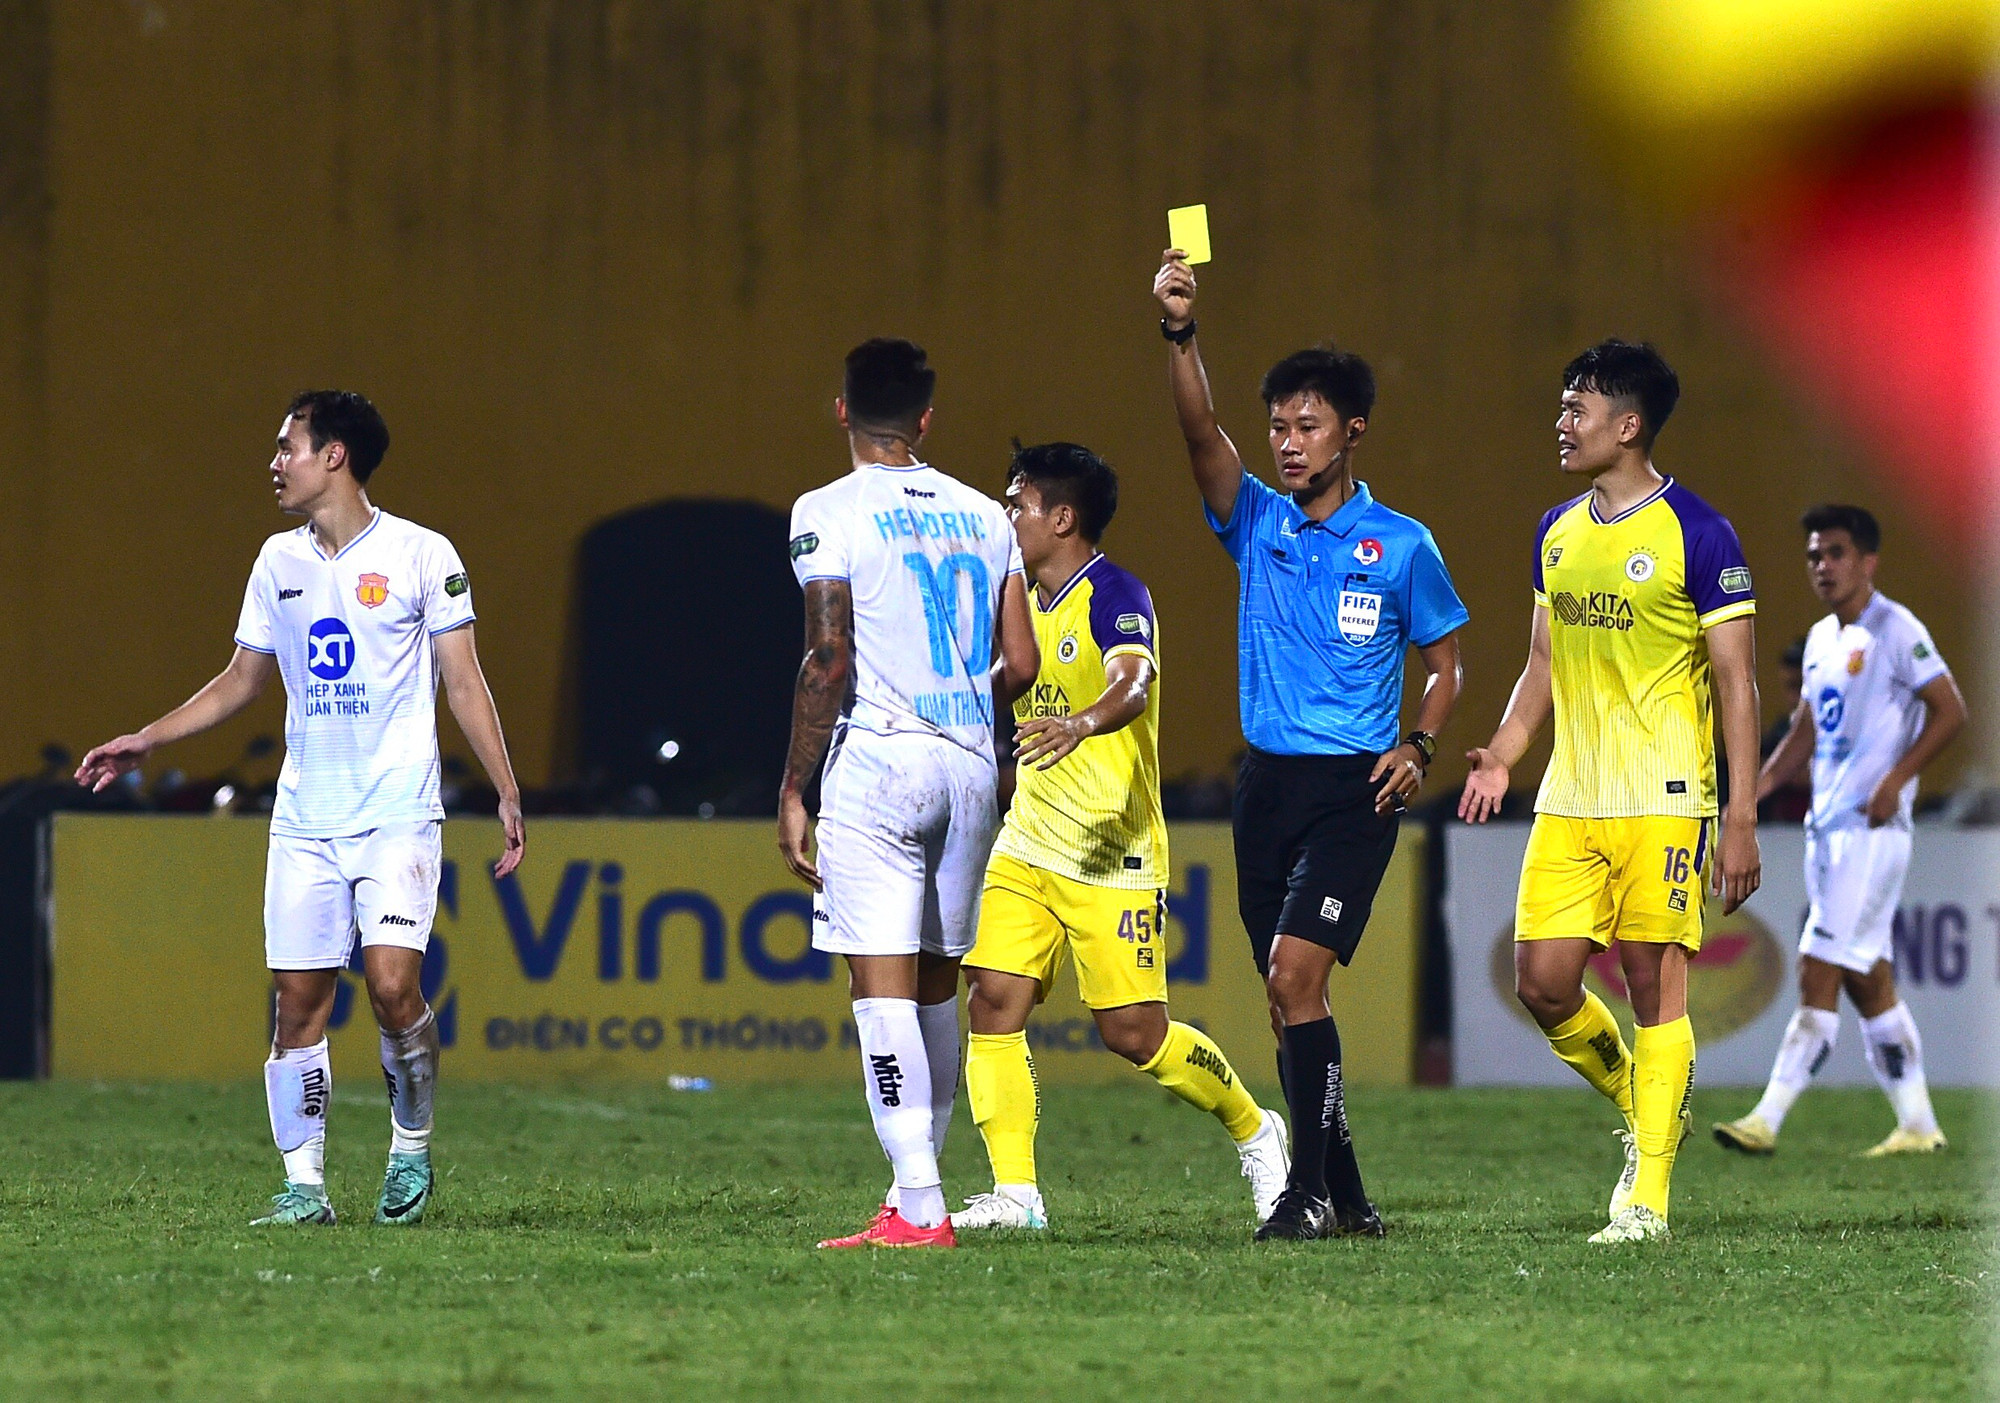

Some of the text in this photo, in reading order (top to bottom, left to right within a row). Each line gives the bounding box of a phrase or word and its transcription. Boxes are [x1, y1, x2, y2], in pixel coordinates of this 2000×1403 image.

[1343, 595, 1377, 611] FIFA
[1589, 592, 1634, 618] KITA
[903, 552, 991, 679] 10
[1341, 616, 1376, 627] REFEREE
[1588, 613, 1634, 631] GROUP
[306, 681, 366, 699] HÉP XANH
[305, 699, 331, 717] UÂN
[1663, 846, 1690, 884] 16
[379, 913, 418, 928] Mitre
[1117, 909, 1151, 943] 45
[869, 1053, 905, 1108] Mitre
[1320, 1062, 1341, 1129] JOGARBOLA
